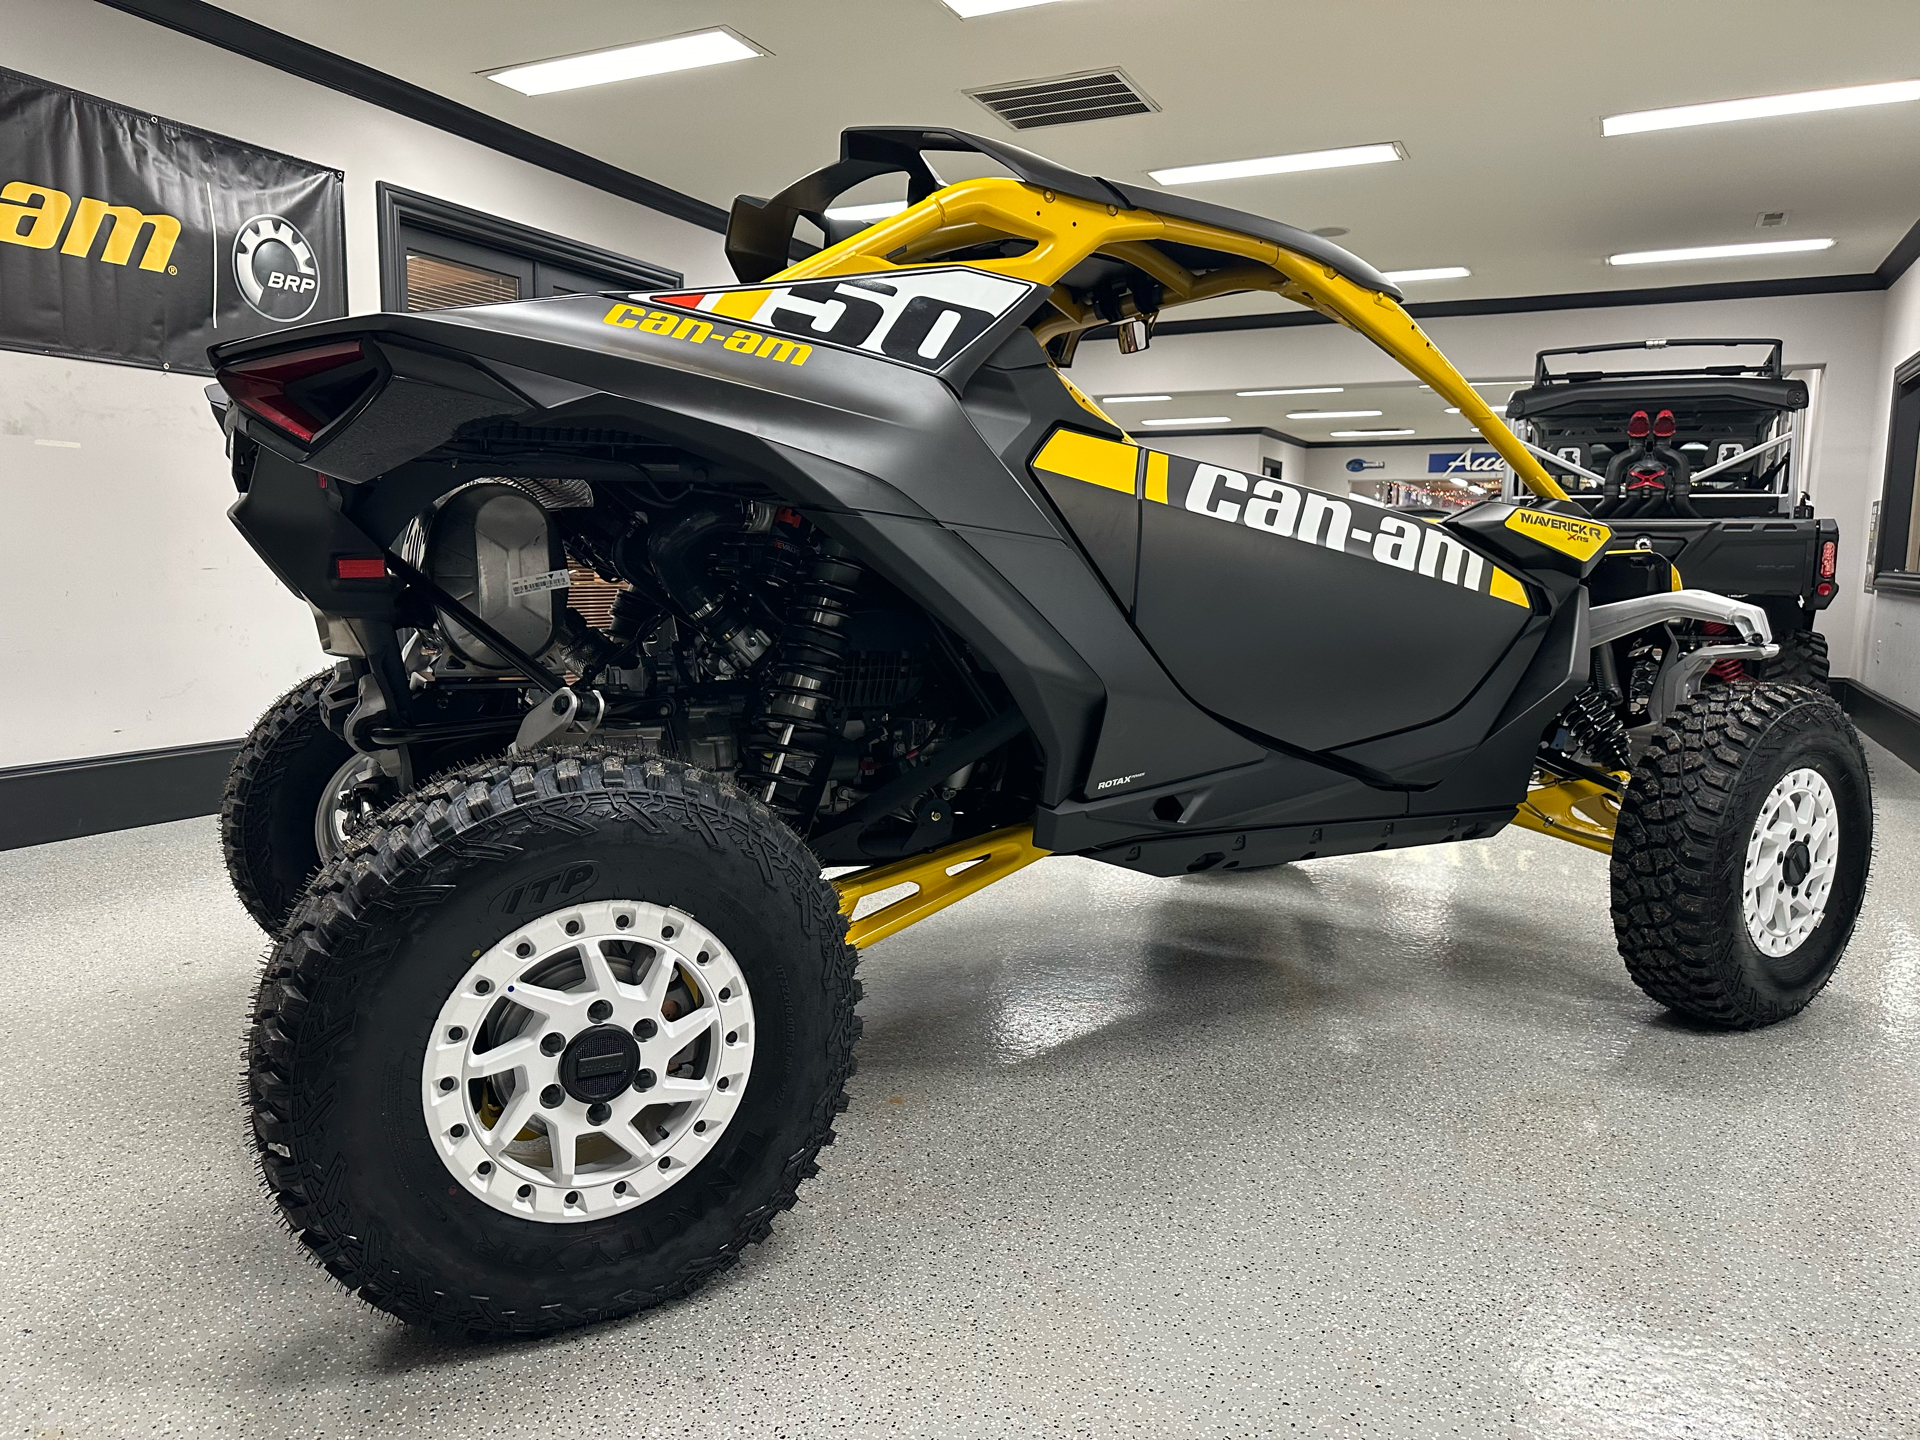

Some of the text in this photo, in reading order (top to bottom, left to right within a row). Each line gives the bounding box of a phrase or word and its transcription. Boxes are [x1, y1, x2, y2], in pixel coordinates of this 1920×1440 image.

[267, 271, 316, 294] BRP
[603, 303, 814, 366] can-am
[1185, 463, 1484, 592] can-am
[1520, 512, 1601, 540] MAVERICK R
[1097, 775, 1131, 790] ROTAX
[502, 864, 594, 915] ITP
[581, 1127, 771, 1270] TENACITY
